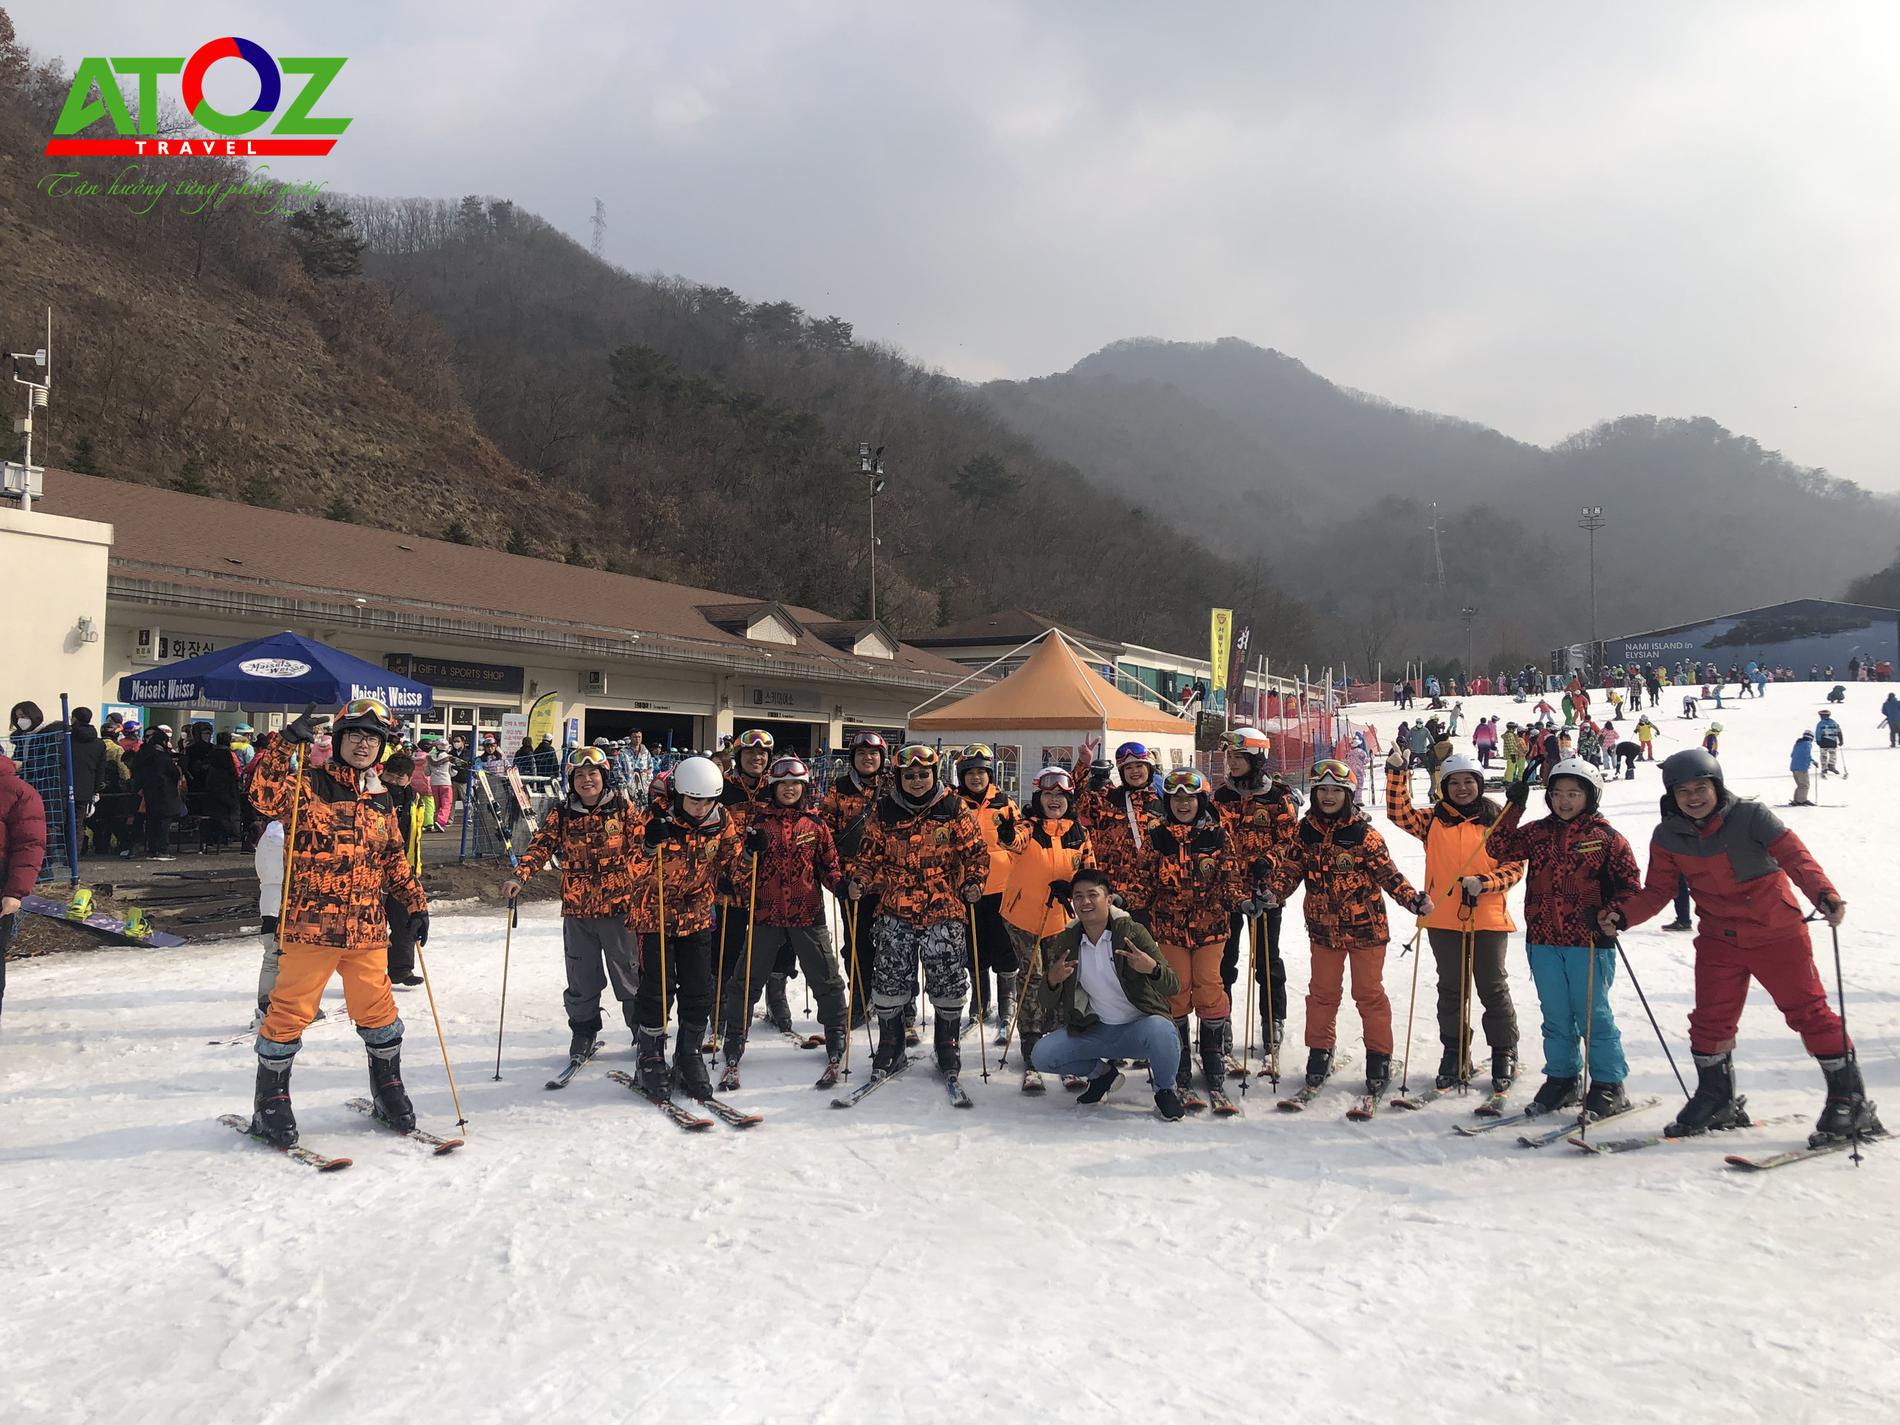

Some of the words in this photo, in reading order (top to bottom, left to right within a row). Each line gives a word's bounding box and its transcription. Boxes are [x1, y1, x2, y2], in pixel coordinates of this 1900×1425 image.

[1625, 643, 1649, 651] NAMI
[1651, 641, 1682, 650] ISLAND
[1625, 651, 1659, 659] ELYSIAN
[418, 663, 438, 675] GIFT
[440, 665, 447, 676] &
[449, 666, 481, 679] SPORTS
[483, 669, 505, 680] SHOP
[131, 680, 166, 701] Maisel's
[167, 679, 195, 700] Weisse
[388, 686, 423, 707] Weisse
